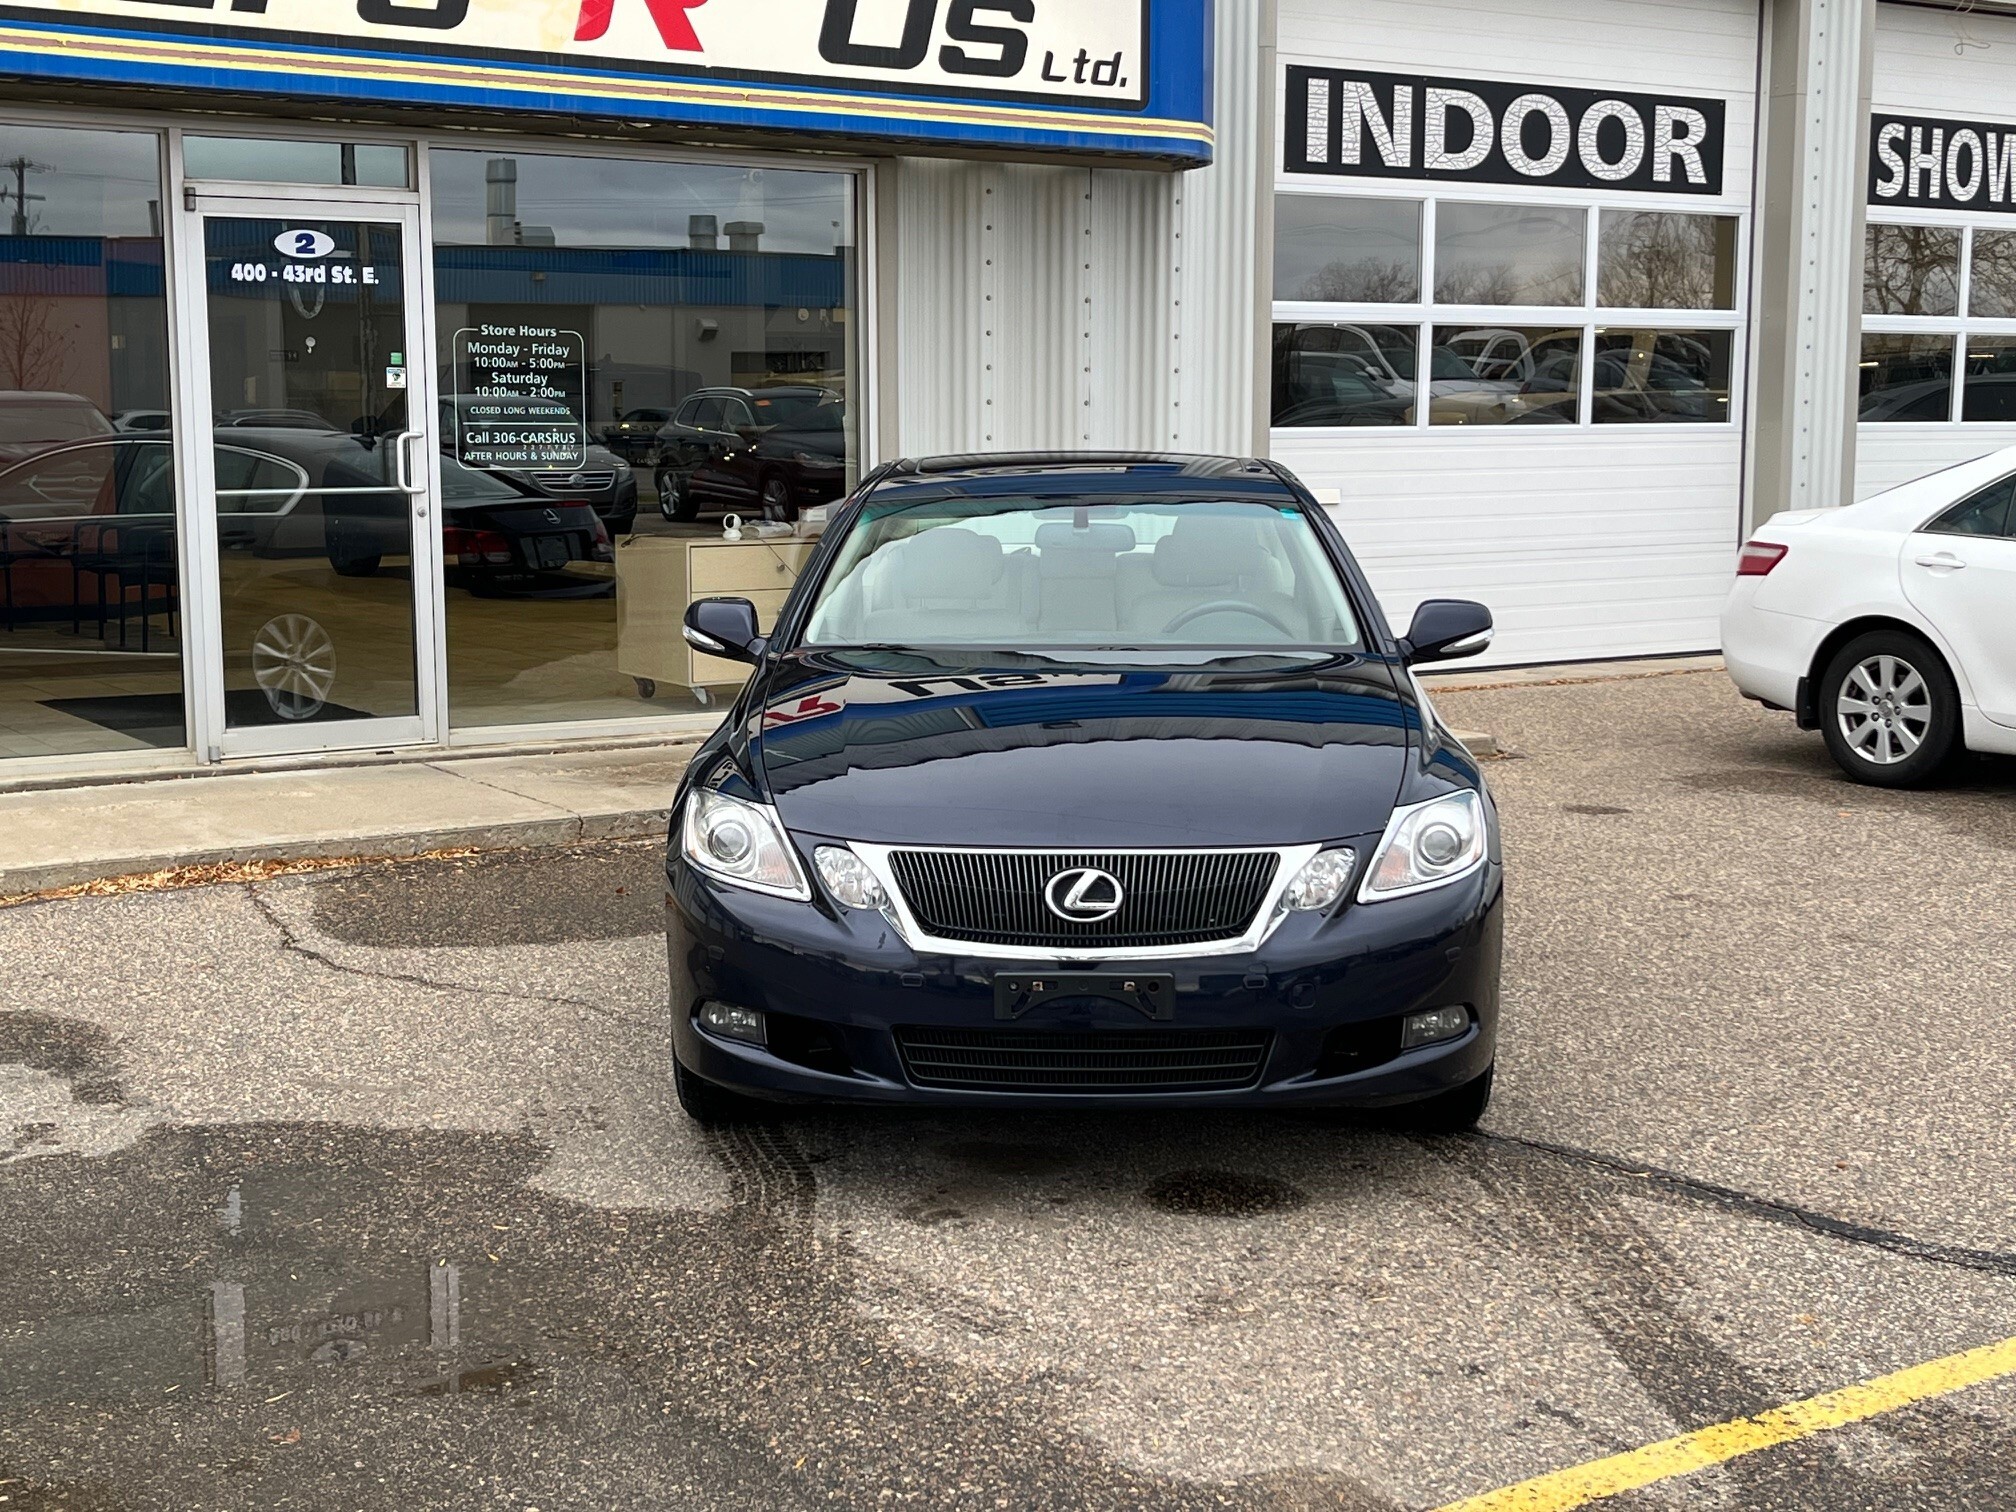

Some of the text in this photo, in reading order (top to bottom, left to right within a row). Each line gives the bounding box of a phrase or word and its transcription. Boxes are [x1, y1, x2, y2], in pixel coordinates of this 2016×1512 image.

[1041, 48, 1127, 87] Ltd.
[1306, 77, 1708, 184] INDOOR
[295, 233, 315, 254] 2
[231, 263, 266, 281] 400
[283, 265, 326, 282] 43rd
[331, 266, 357, 284] St.
[363, 267, 379, 284] E.
[481, 324, 557, 337] Store Hours
[468, 342, 520, 357] Monday
[532, 343, 570, 358] Friday
[492, 372, 548, 386] Saturday
[467, 432, 576, 443] Call 306-CARSRUS
[464, 452, 578, 460] AFTER HOURS & SUNDAY
